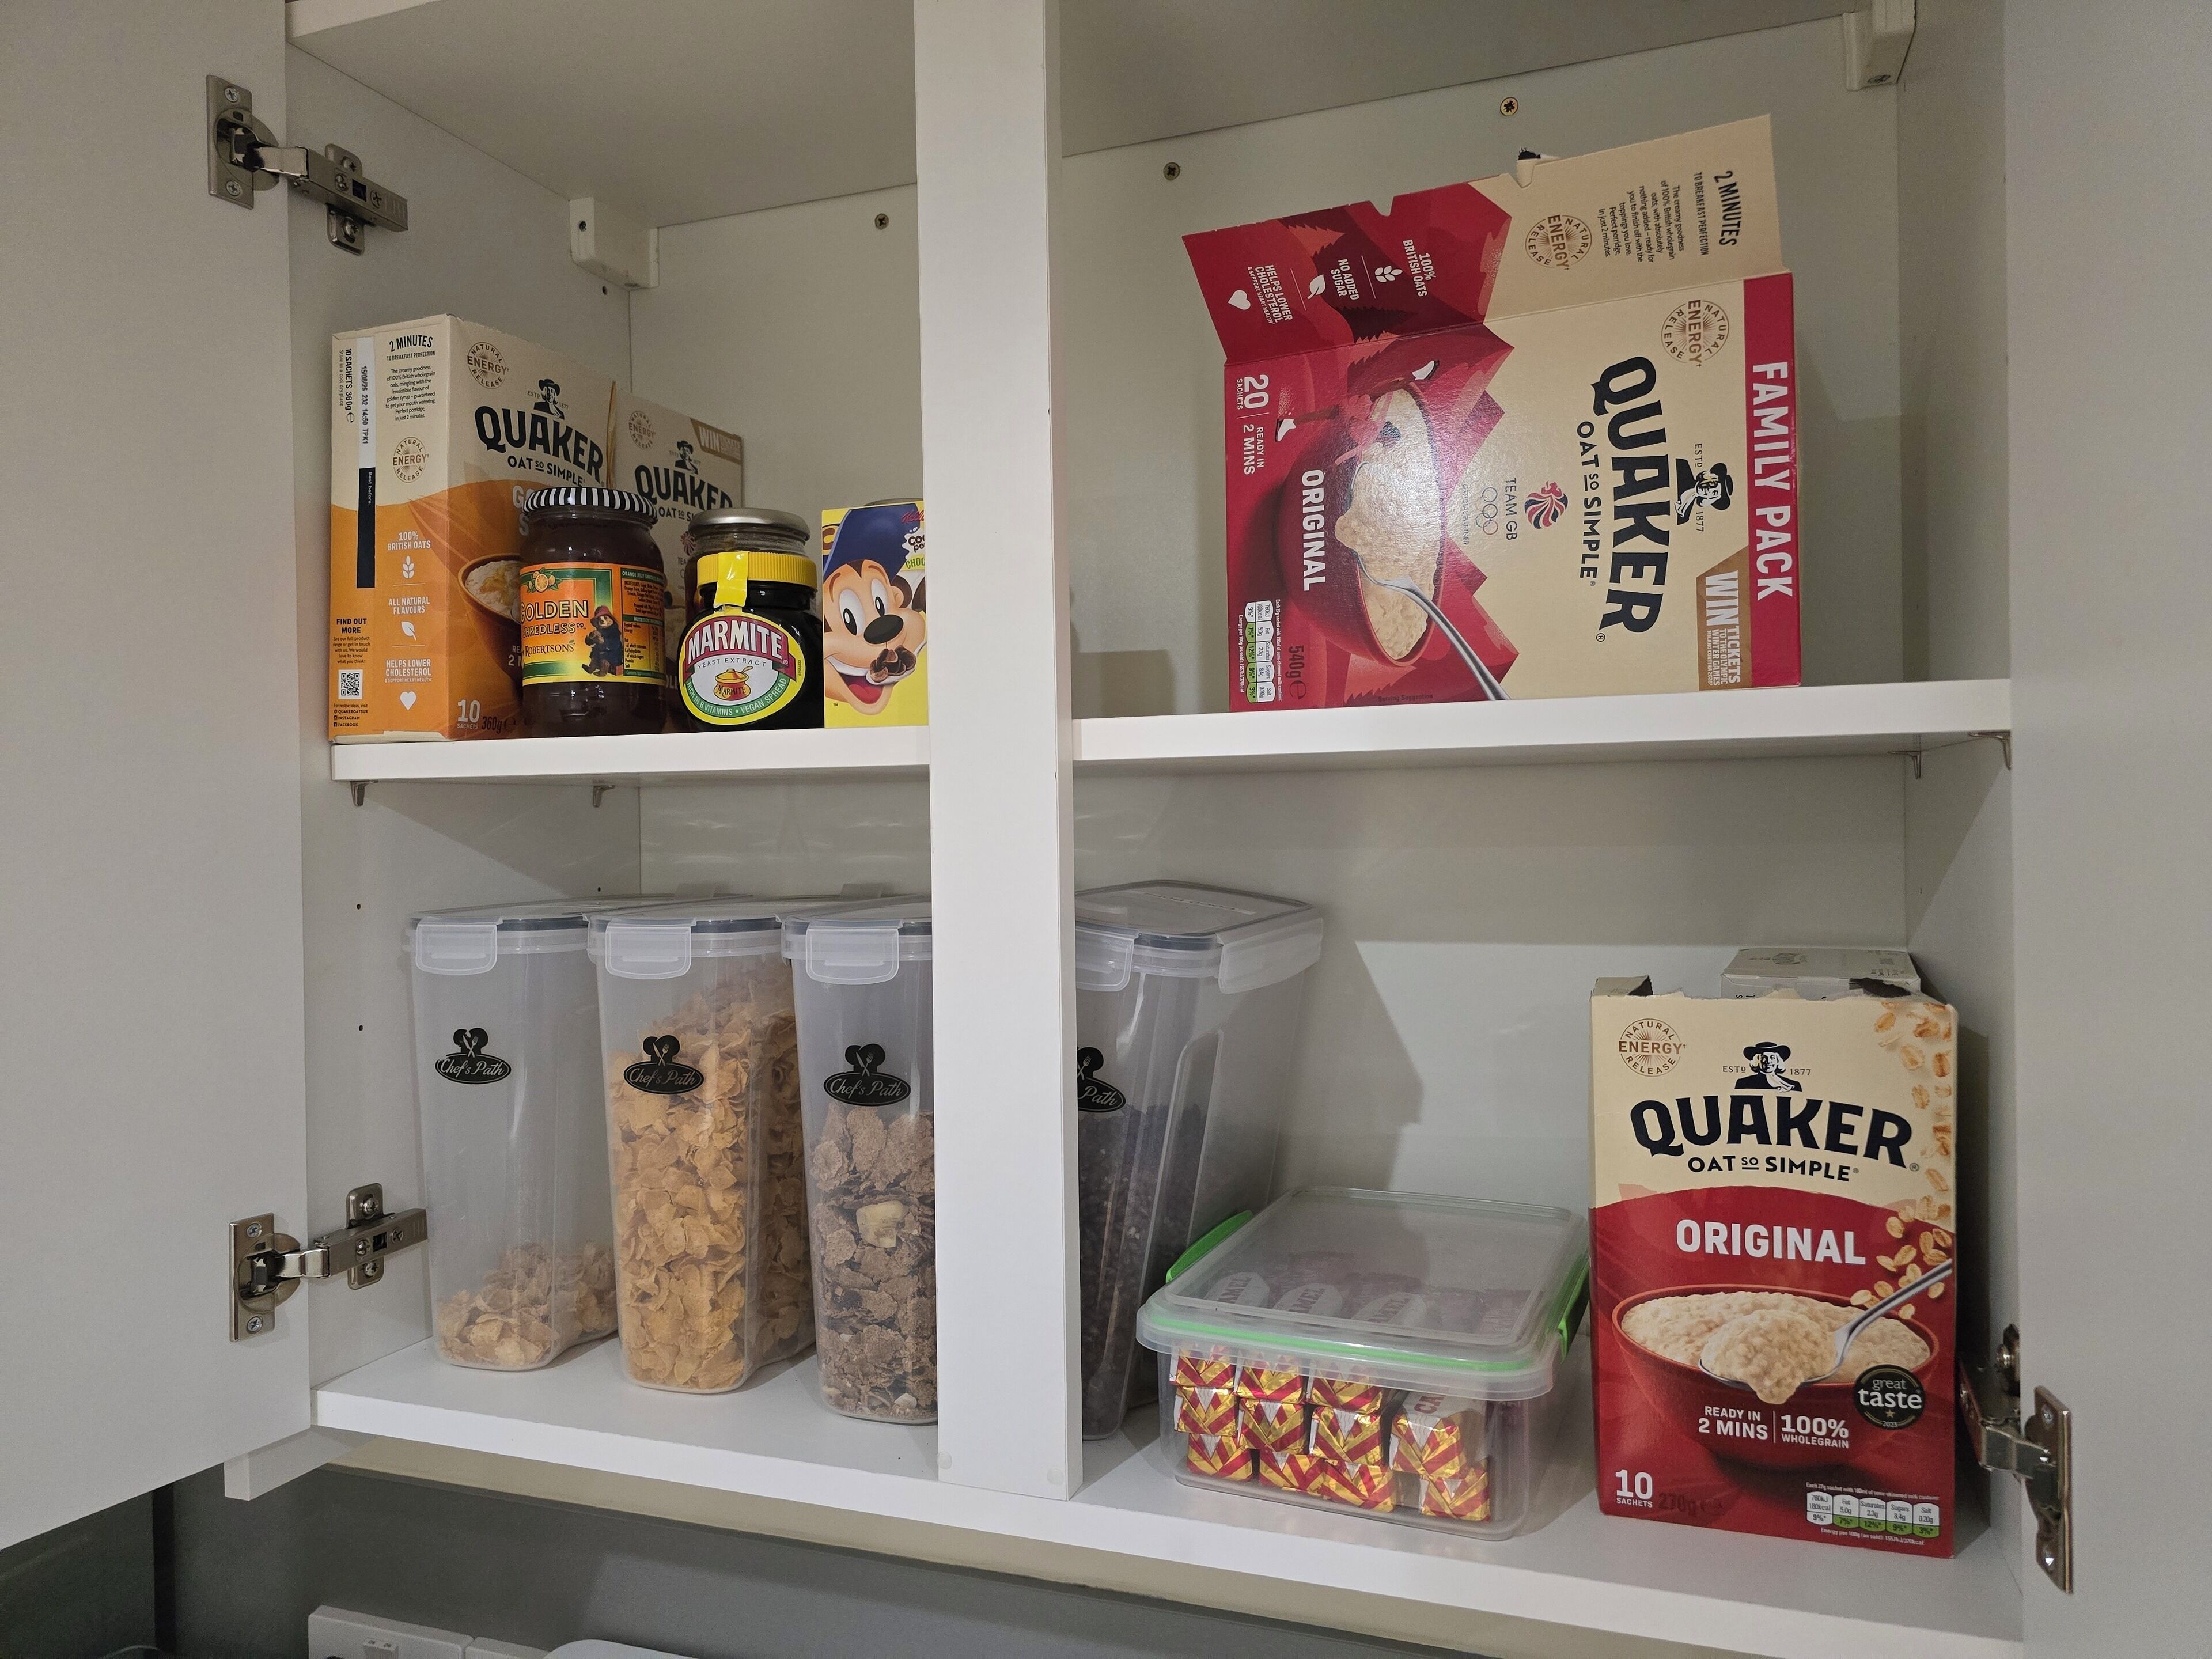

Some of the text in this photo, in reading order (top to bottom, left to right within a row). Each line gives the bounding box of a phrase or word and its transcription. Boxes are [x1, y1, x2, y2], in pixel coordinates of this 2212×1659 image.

[1694, 172, 1709, 255] TO BREAKFAST PERFECTION
[1714, 171, 1741, 246] 2 MINUTES
[1528, 225, 1551, 265] RELEASE
[1565, 218, 1589, 259] NATURAL
[1403, 240, 1427, 297] BRITISH OATS
[1419, 252, 1437, 281] 100%
[1249, 271, 1260, 291] SUPPORT
[1257, 292, 1267, 309] HEART
[1331, 269, 1347, 297] SUGAR
[1338, 259, 1359, 300] NO ADDED
[1255, 267, 1283, 323] CHOLESTEROL
[1265, 265, 1293, 321] HELPS LOWER
[1664, 309, 1684, 359] RELEASE
[1705, 305, 1726, 354] NATURAL
[389, 335, 433, 352] 2 MINUTES
[471, 344, 503, 363] NATURAL
[392, 353, 413, 361] BREAKFAST
[472, 369, 503, 387] RELEASE
[1244, 374, 1269, 409] 20
[396, 439, 423, 454] NATURAL
[475, 406, 603, 484] QUAKER
[698, 426, 721, 453] WIN
[1244, 424, 1255, 475] 2 MINS
[508, 456, 533, 469] OAT
[1257, 458, 1264, 468] IN
[1577, 421, 1599, 468] OAT
[1589, 474, 1599, 490] SO
[396, 467, 423, 481] RELEASE
[1753, 362, 1793, 601] FAMILY PACK
[1590, 356, 1670, 633] QUAKER
[659, 506, 676, 519] OAT
[1505, 478, 1518, 540] TEAM GB
[1302, 470, 1325, 591] ORIGINAL
[1696, 512, 1705, 532] 1877
[388, 540, 431, 551] BRITISH OATS
[399, 531, 418, 541] 100%
[389, 597, 430, 606] ALL NATURAL
[393, 607, 425, 615] FLAVOURS
[1706, 570, 1741, 684] WIN TICKETS
[1719, 628, 1727, 638] TO
[688, 620, 782, 665] MARMITE
[387, 660, 407, 668] HELPS
[509, 654, 514, 666] 2
[698, 658, 767, 669] YEAST EXTRACT
[1286, 645, 1304, 679] 540g
[386, 668, 431, 676] CHOLESTEROL
[1713, 660, 1721, 685] GAMES
[694, 696, 699, 705] IN
[704, 705, 733, 715] VITAMINS
[740, 699, 765, 714] VEGAN
[766, 678, 787, 703] SPREAD
[719, 685, 746, 698] MARMITE
[457, 699, 502, 734] 10 360g
[1625, 1021, 1674, 1040] NATURAL
[440, 1058, 505, 1076] Chef's Path
[1626, 1056, 1676, 1074] RELEASE
[630, 1068, 696, 1087] Chef's Path
[830, 1078, 903, 1099] Chef's Path
[1082, 1086, 1118, 1105] Path
[1630, 1095, 1912, 1169] QUAKER
[1688, 1156, 1736, 1173] OAT
[1742, 1157, 1759, 1166] SO
[1676, 1219, 1866, 1265] ORIGINAL
[1872, 1378, 1907, 1391] great
[1858, 1388, 1922, 1409] taste
[1705, 1406, 1760, 1421] READY IN
[1698, 1418, 1767, 1440] 2 MINS
[1781, 1414, 1849, 1438] 100%
[1782, 1433, 1849, 1448] WHOLEGRAIN
[1615, 1469, 1653, 1499] 10
[1616, 1497, 1653, 1508] SACHETS
